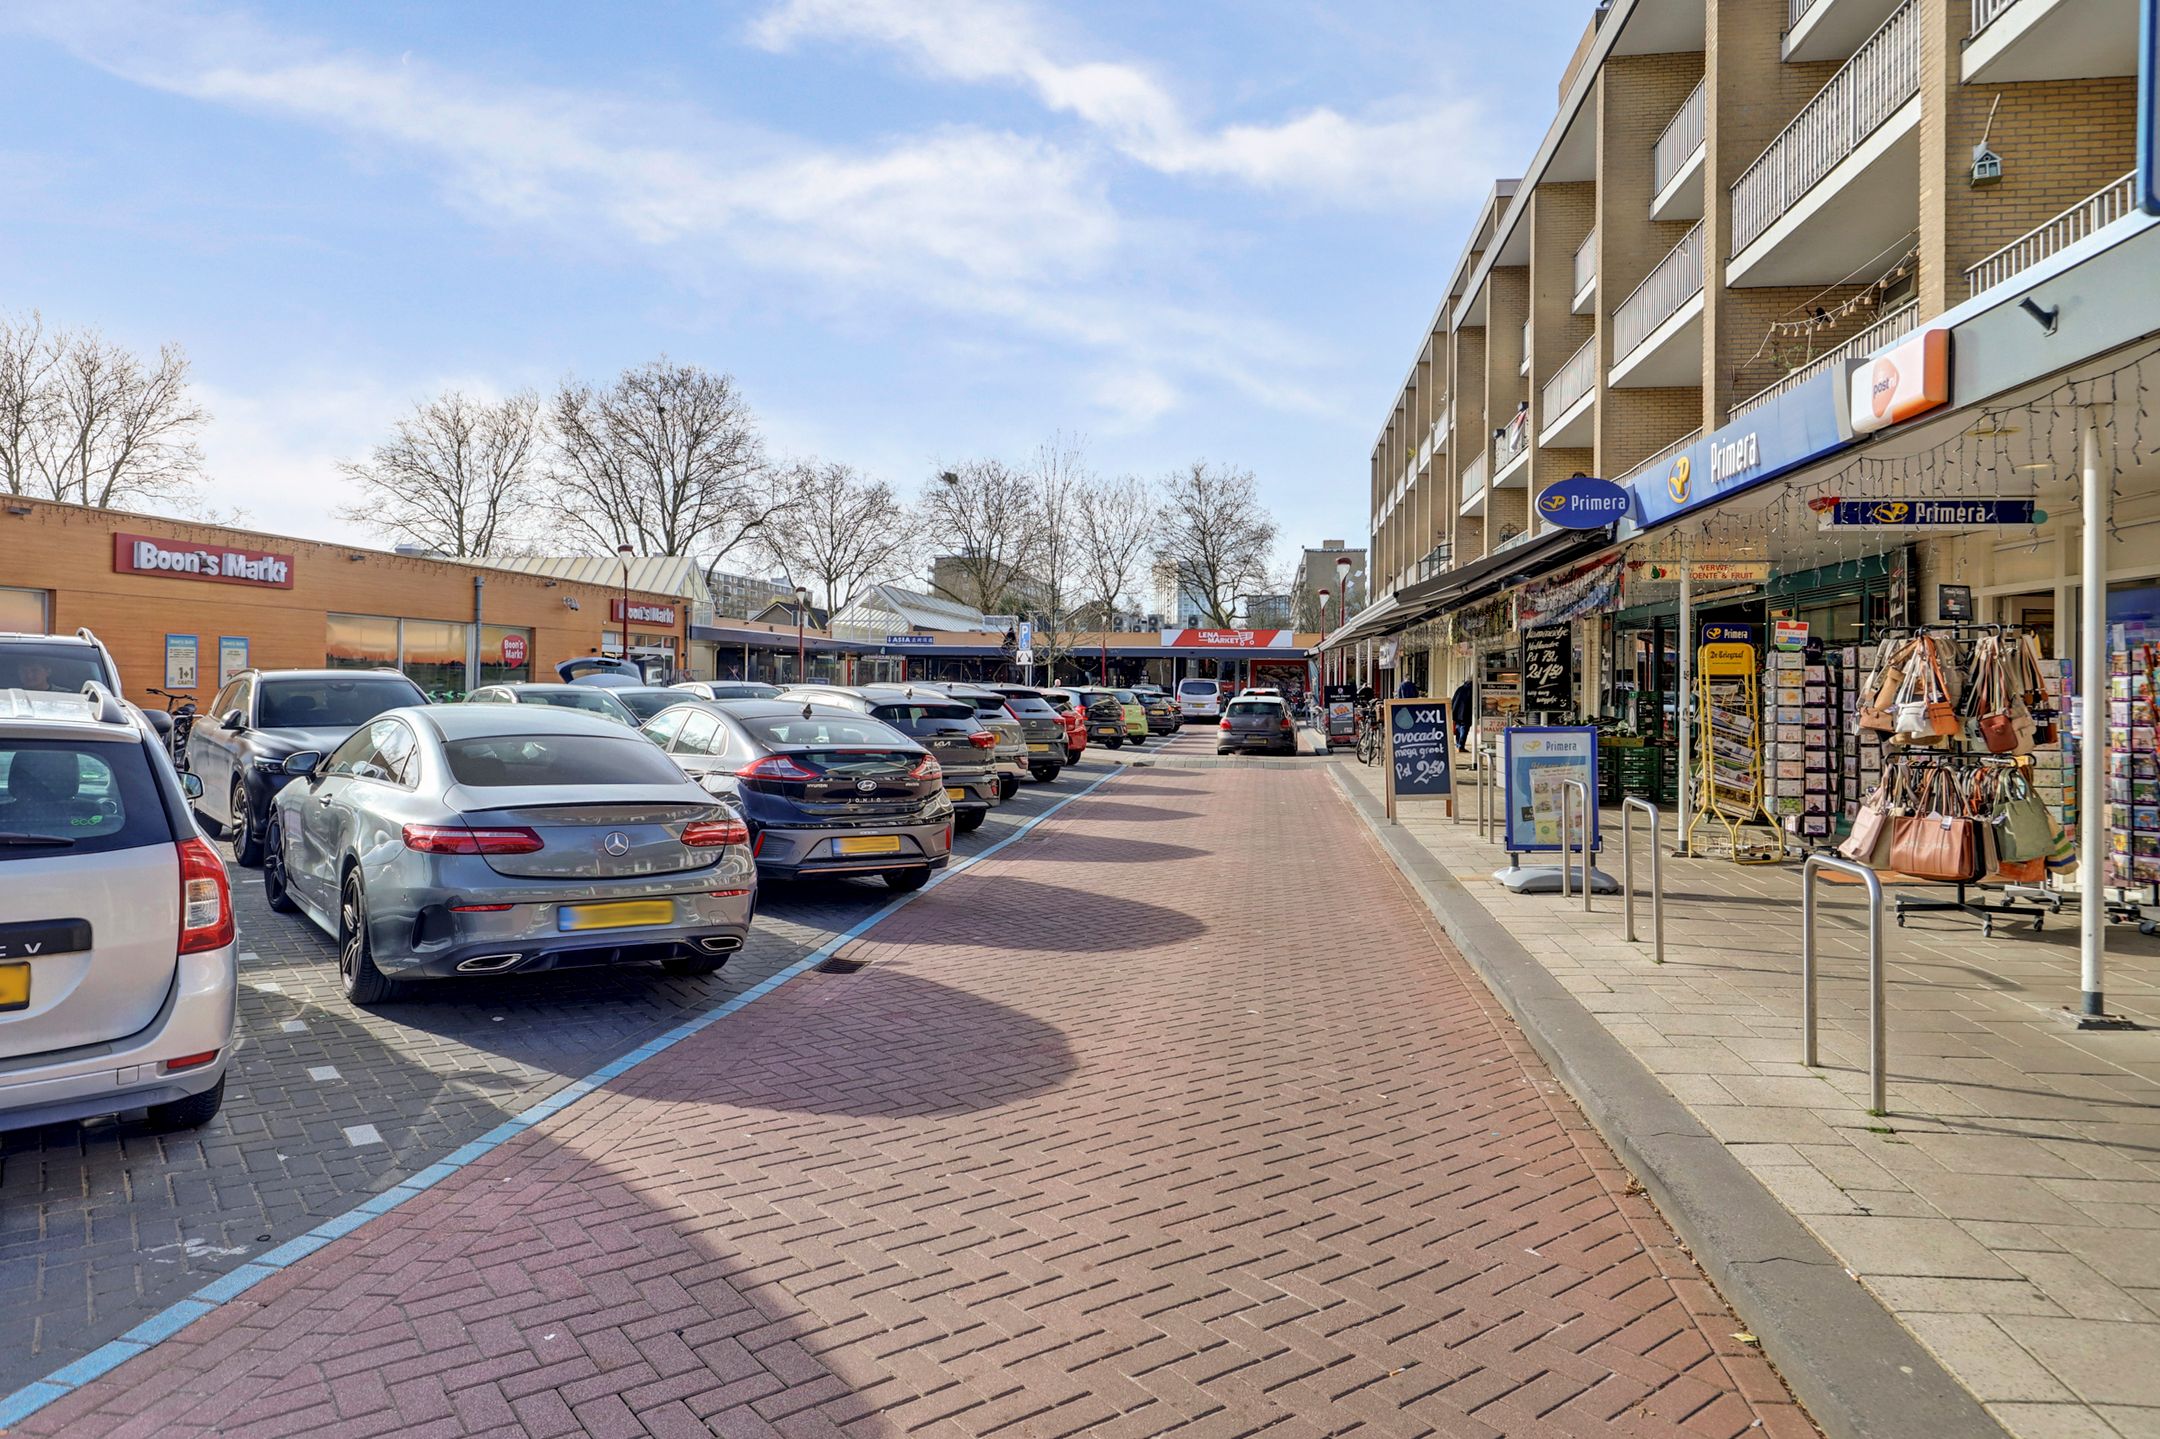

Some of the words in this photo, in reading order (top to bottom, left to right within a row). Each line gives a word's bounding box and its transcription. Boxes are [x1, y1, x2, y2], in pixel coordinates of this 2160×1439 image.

[1711, 432, 1758, 483] Primera
[1571, 494, 1626, 511] Primera
[1915, 502, 1986, 523] Primera
[133, 541, 220, 576] Boon's
[221, 552, 288, 583] Markt
[649, 606, 675, 624] Markt
[1021, 625, 1029, 639] P
[1723, 628, 1748, 639] Primera
[504, 640, 524, 650] Boon's
[505, 649, 524, 660] Markt
[178, 666, 194, 680] 1+1
[1415, 709, 1445, 724] XXL
[1393, 727, 1444, 744] avocado
[1395, 748, 1418, 759] mega
[1419, 743, 1445, 759] groot
[1545, 741, 1577, 752] Primera
